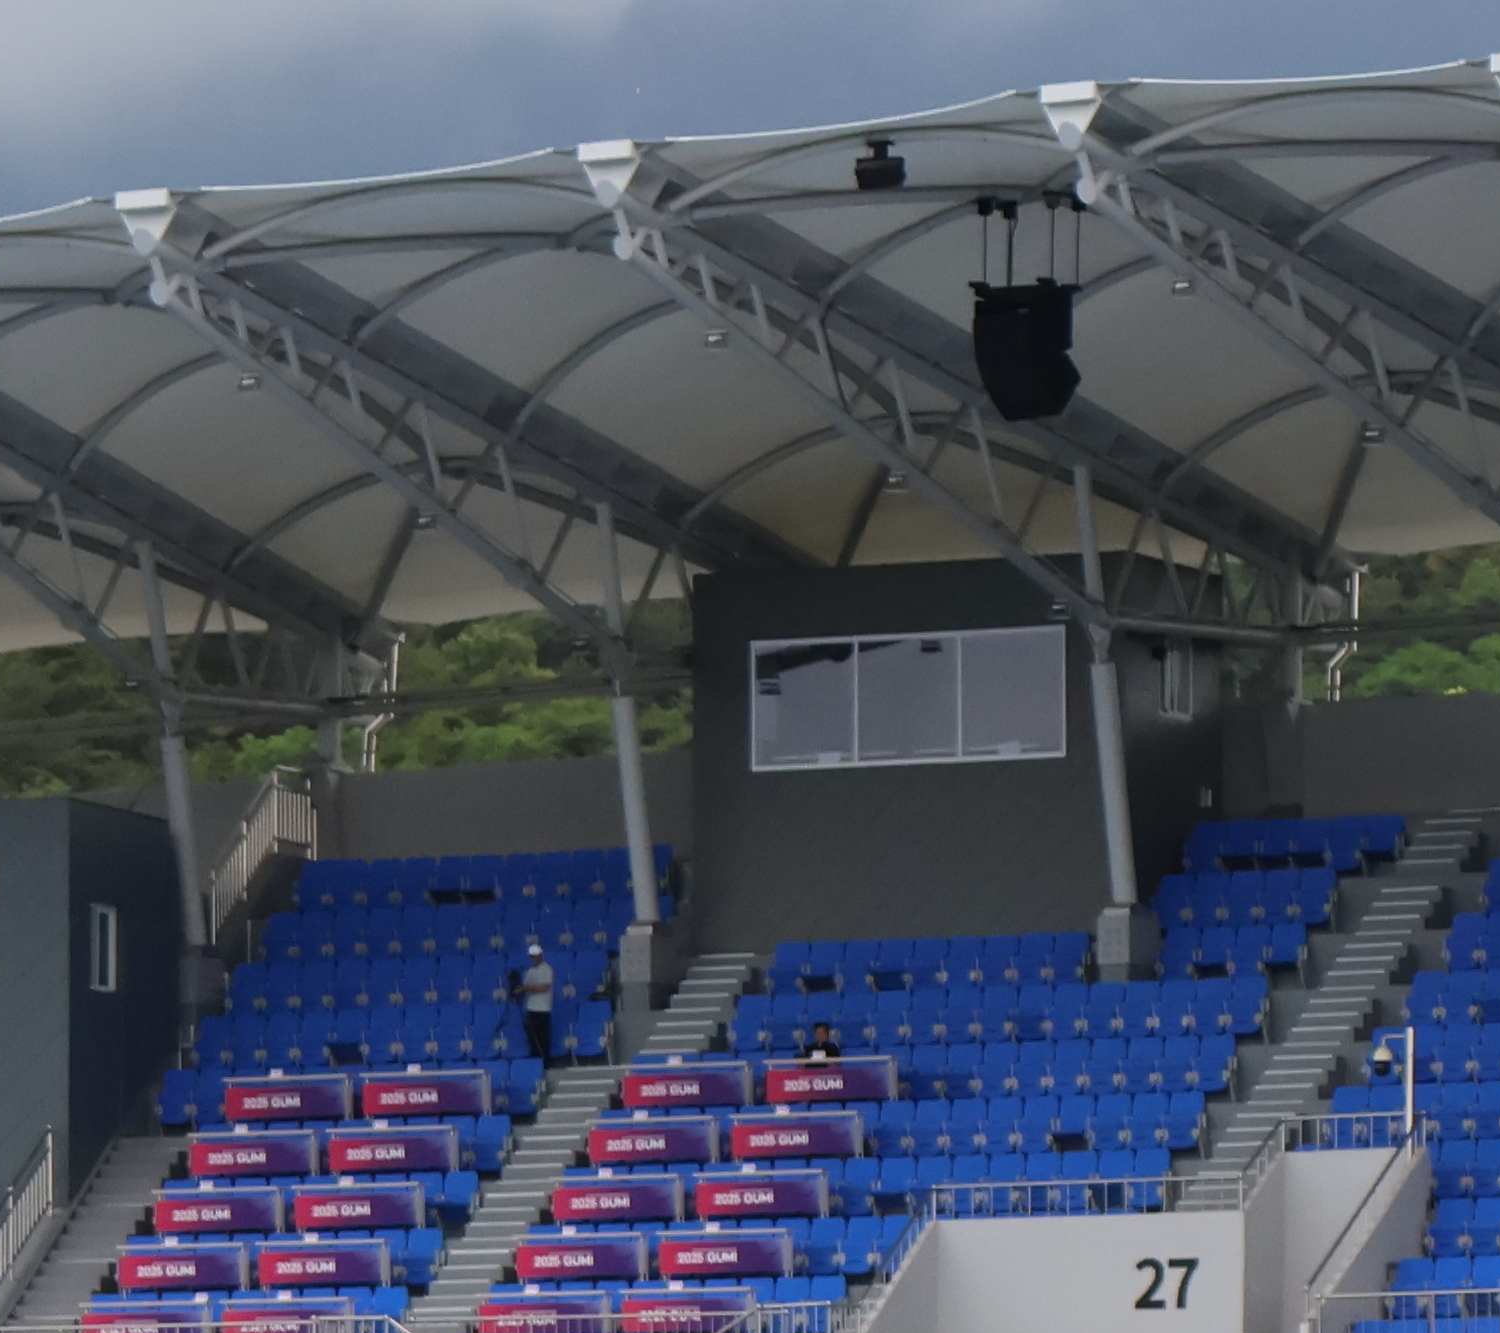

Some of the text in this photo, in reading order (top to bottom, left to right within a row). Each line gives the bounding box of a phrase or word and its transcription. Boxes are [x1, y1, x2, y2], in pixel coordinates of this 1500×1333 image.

[640, 1083, 700, 1097] 2025 GUMI
[813, 1078, 843, 1091] GUMI
[243, 1096, 300, 1109] 2025 GUMI
[380, 1091, 438, 1105] 2025 GUMI
[606, 1138, 666, 1152] 2025 GUMI
[750, 1132, 809, 1147] 2025 GUMI
[208, 1152, 266, 1165] 2025 GUMI
[347, 1147, 405, 1161] 2025 GUMI
[571, 1196, 630, 1210] 2025 GUMI
[715, 1191, 774, 1205] 2025 GUMI
[172, 1208, 231, 1222] 2025 GUMI
[312, 1203, 371, 1217] 2025 GUMI
[534, 1254, 594, 1268] 2025 GUMI
[677, 1250, 738, 1264] 2025 GUMI
[137, 1263, 196, 1277] 2025 GUMI
[276, 1260, 336, 1274] 2025 GUMI
[1135, 1257, 1199, 1310] 27
